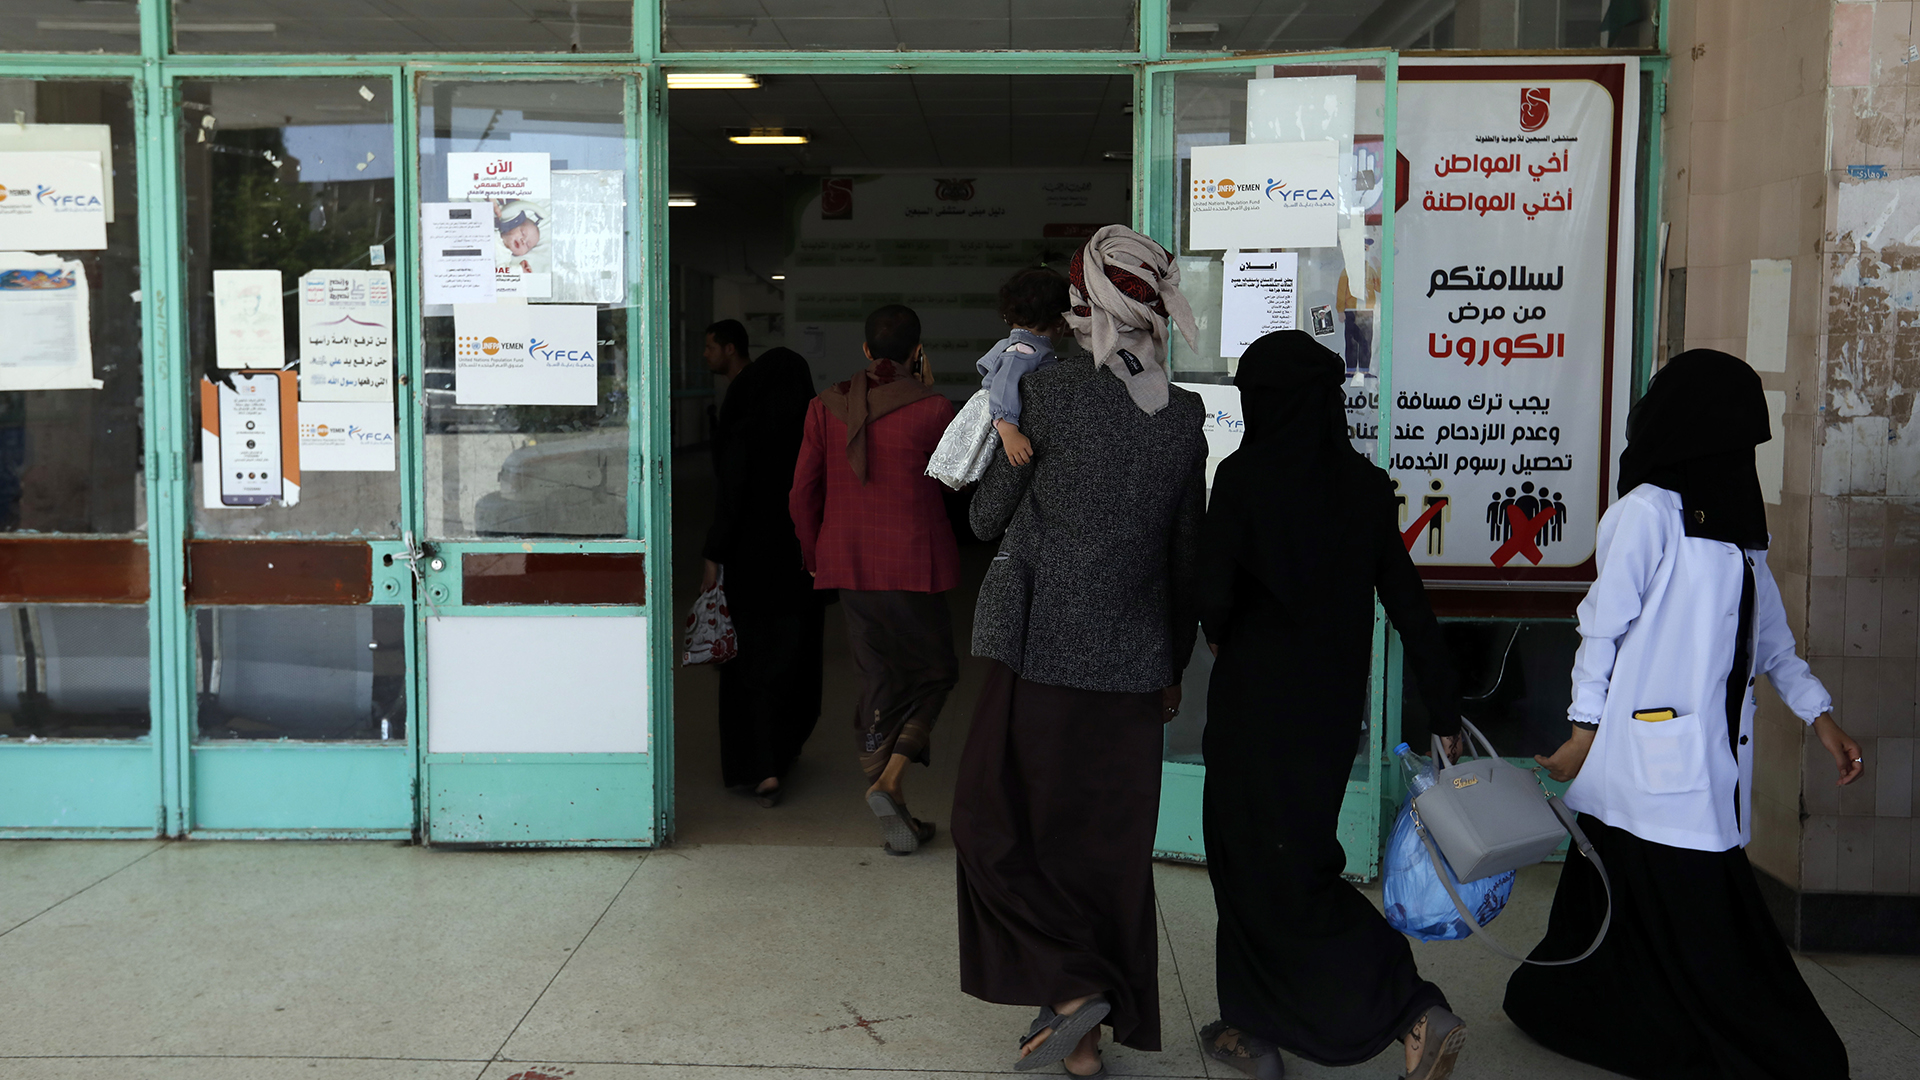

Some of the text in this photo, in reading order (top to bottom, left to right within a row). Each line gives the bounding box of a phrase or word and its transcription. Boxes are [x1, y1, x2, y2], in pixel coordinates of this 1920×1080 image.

[1526, 134, 1550, 144] السبعين
[1551, 133, 1578, 143] مستشفى
[486, 160, 512, 175] الآن
[1434, 148, 1568, 182] أخي المواطن
[1236, 184, 1260, 192] YEMEN
[1278, 189, 1335, 201] YFCA
[48, 196, 101, 206] YFCA
[1422, 188, 1572, 220] أختي المواطنة
[905, 206, 1005, 217] دليل مبنى مستشفى السبعين
[1426, 265, 1564, 298] لسلامتكم
[1448, 302, 1546, 325] من مرض
[354, 336, 373, 347] ترفع
[501, 342, 524, 350] YEMEN
[1428, 332, 1565, 366] الكورونا
[353, 356, 372, 367] ترفع
[541, 350, 594, 361] YFCA
[1396, 391, 1461, 410] مسافة
[1468, 393, 1502, 415] ترك
[1508, 396, 1550, 415] يجب
[1226, 420, 1244, 428] YF
[1394, 423, 1424, 440] عند
[1510, 426, 1560, 446] وعدم
[1453, 456, 1506, 476] رسوم
[1512, 454, 1572, 475] تحصيل
